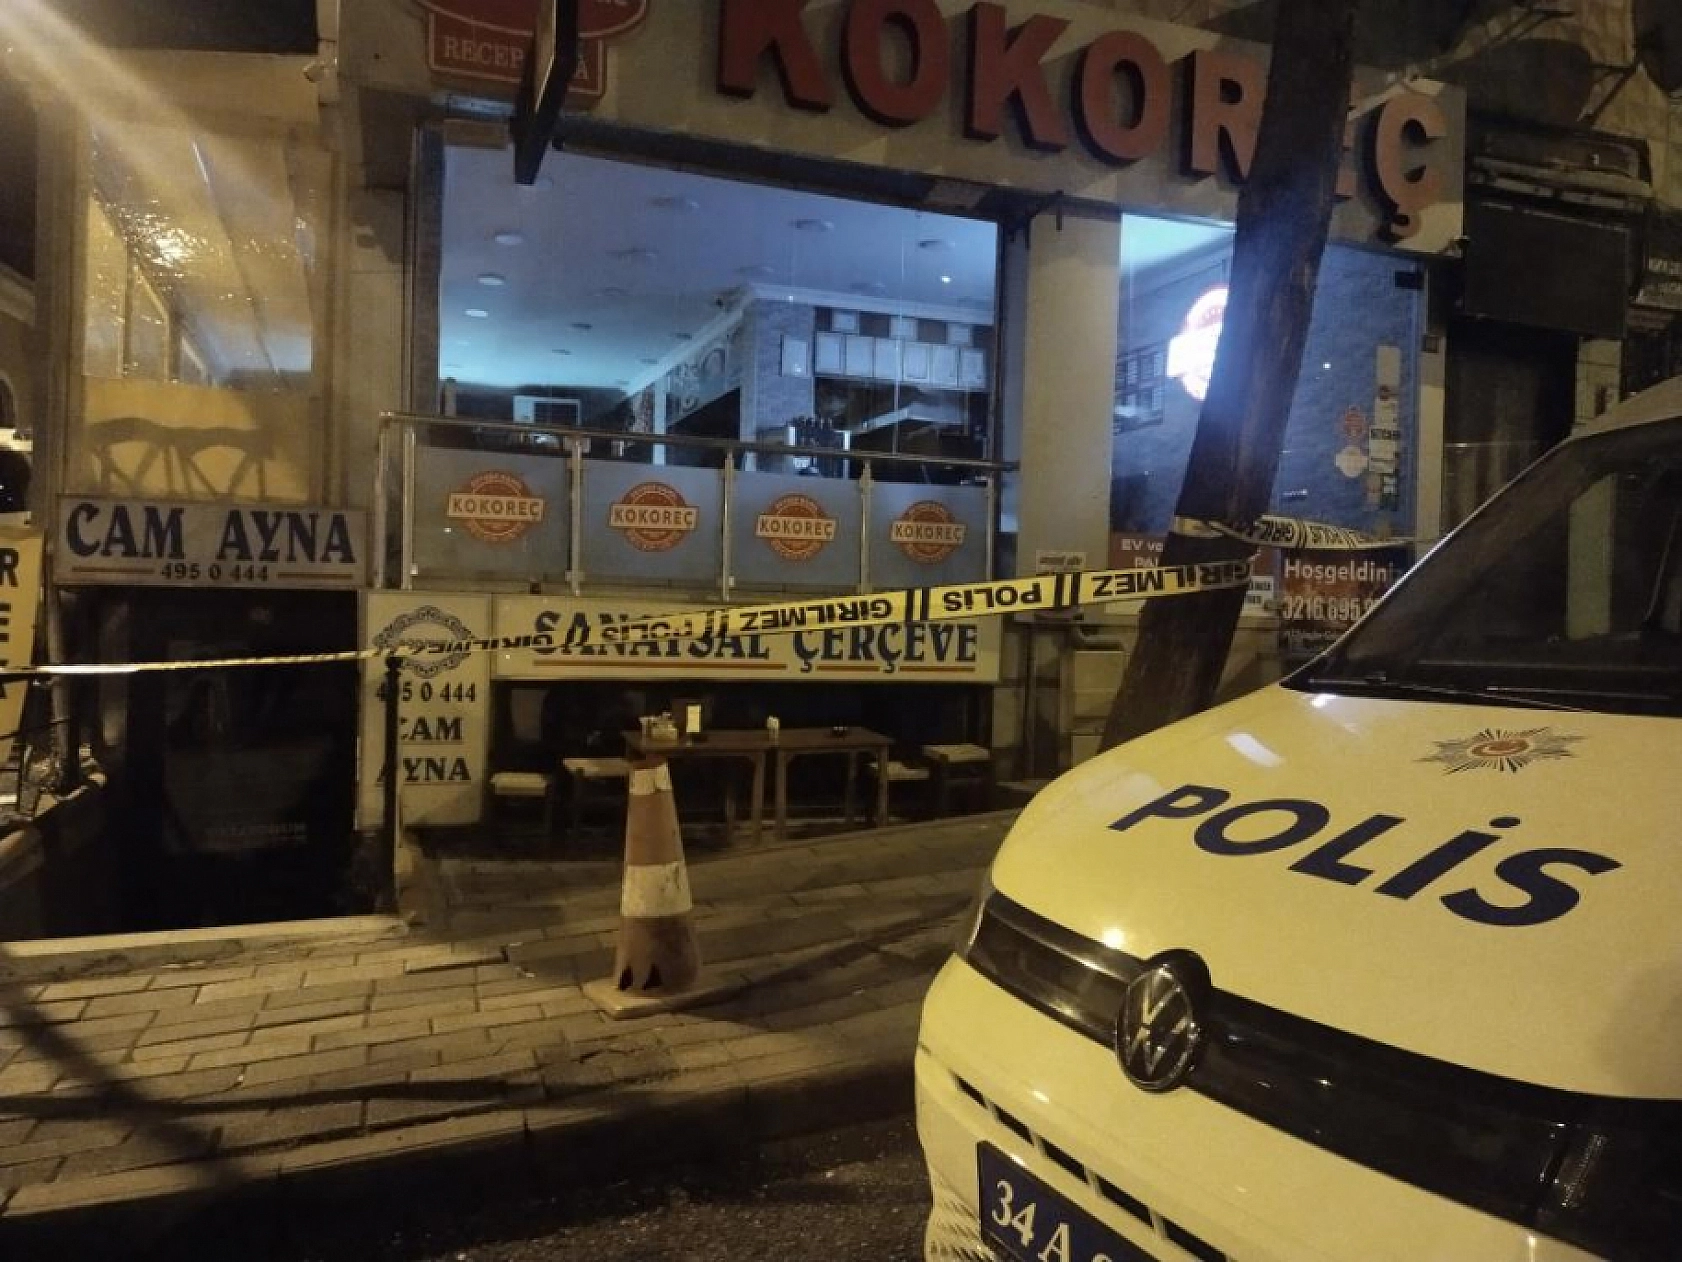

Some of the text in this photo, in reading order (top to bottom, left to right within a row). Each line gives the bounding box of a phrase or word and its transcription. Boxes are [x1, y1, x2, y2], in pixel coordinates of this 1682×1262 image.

[444, 36, 525, 69] RECEP
[717, 0, 1448, 239] KOKORÇ
[67, 503, 356, 564] CAM AYNA
[161, 562, 268, 582] 495 0 444
[942, 583, 1042, 611] POLİS
[793, 621, 978, 674] ÇERÇEVE
[421, 681, 433, 701] 0
[440, 681, 476, 702] 444
[1107, 783, 1622, 926] POLİS
[991, 1180, 1036, 1247] 34
